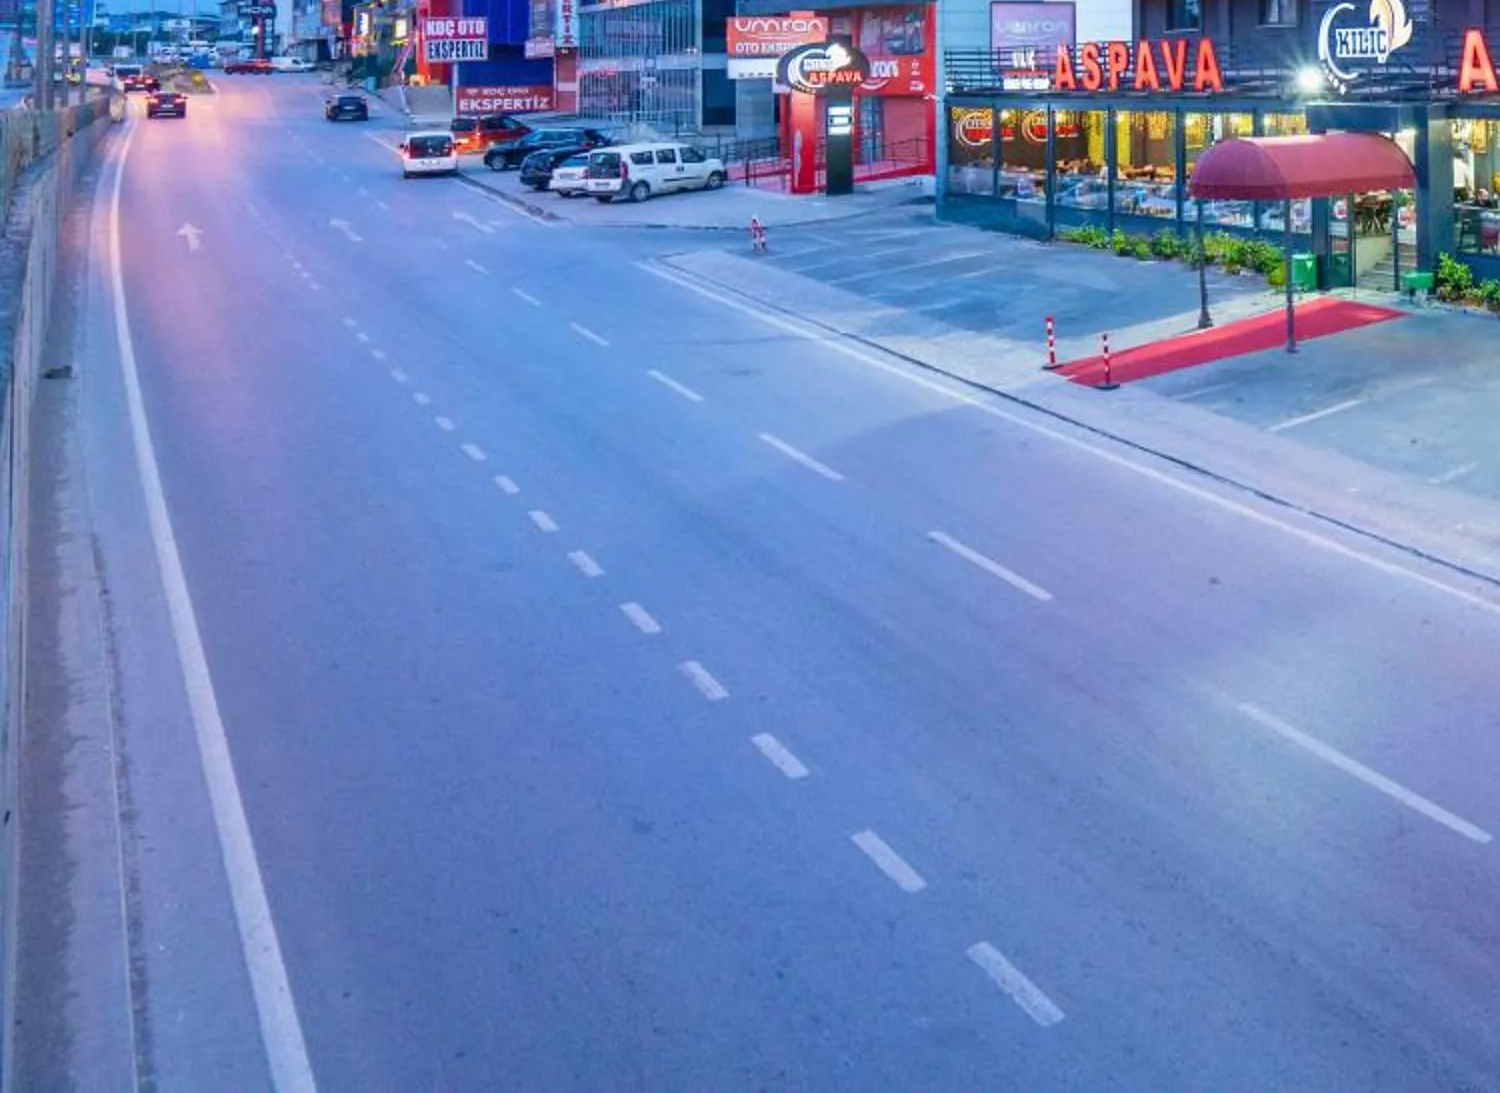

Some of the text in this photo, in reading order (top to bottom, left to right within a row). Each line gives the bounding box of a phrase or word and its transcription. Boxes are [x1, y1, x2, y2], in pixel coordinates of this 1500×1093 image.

[457, 20, 485, 36] OTO
[1055, 36, 1225, 91] ASPAVA
[809, 70, 863, 84] ASPAVA
[460, 94, 551, 111] EKSPERTİZ
